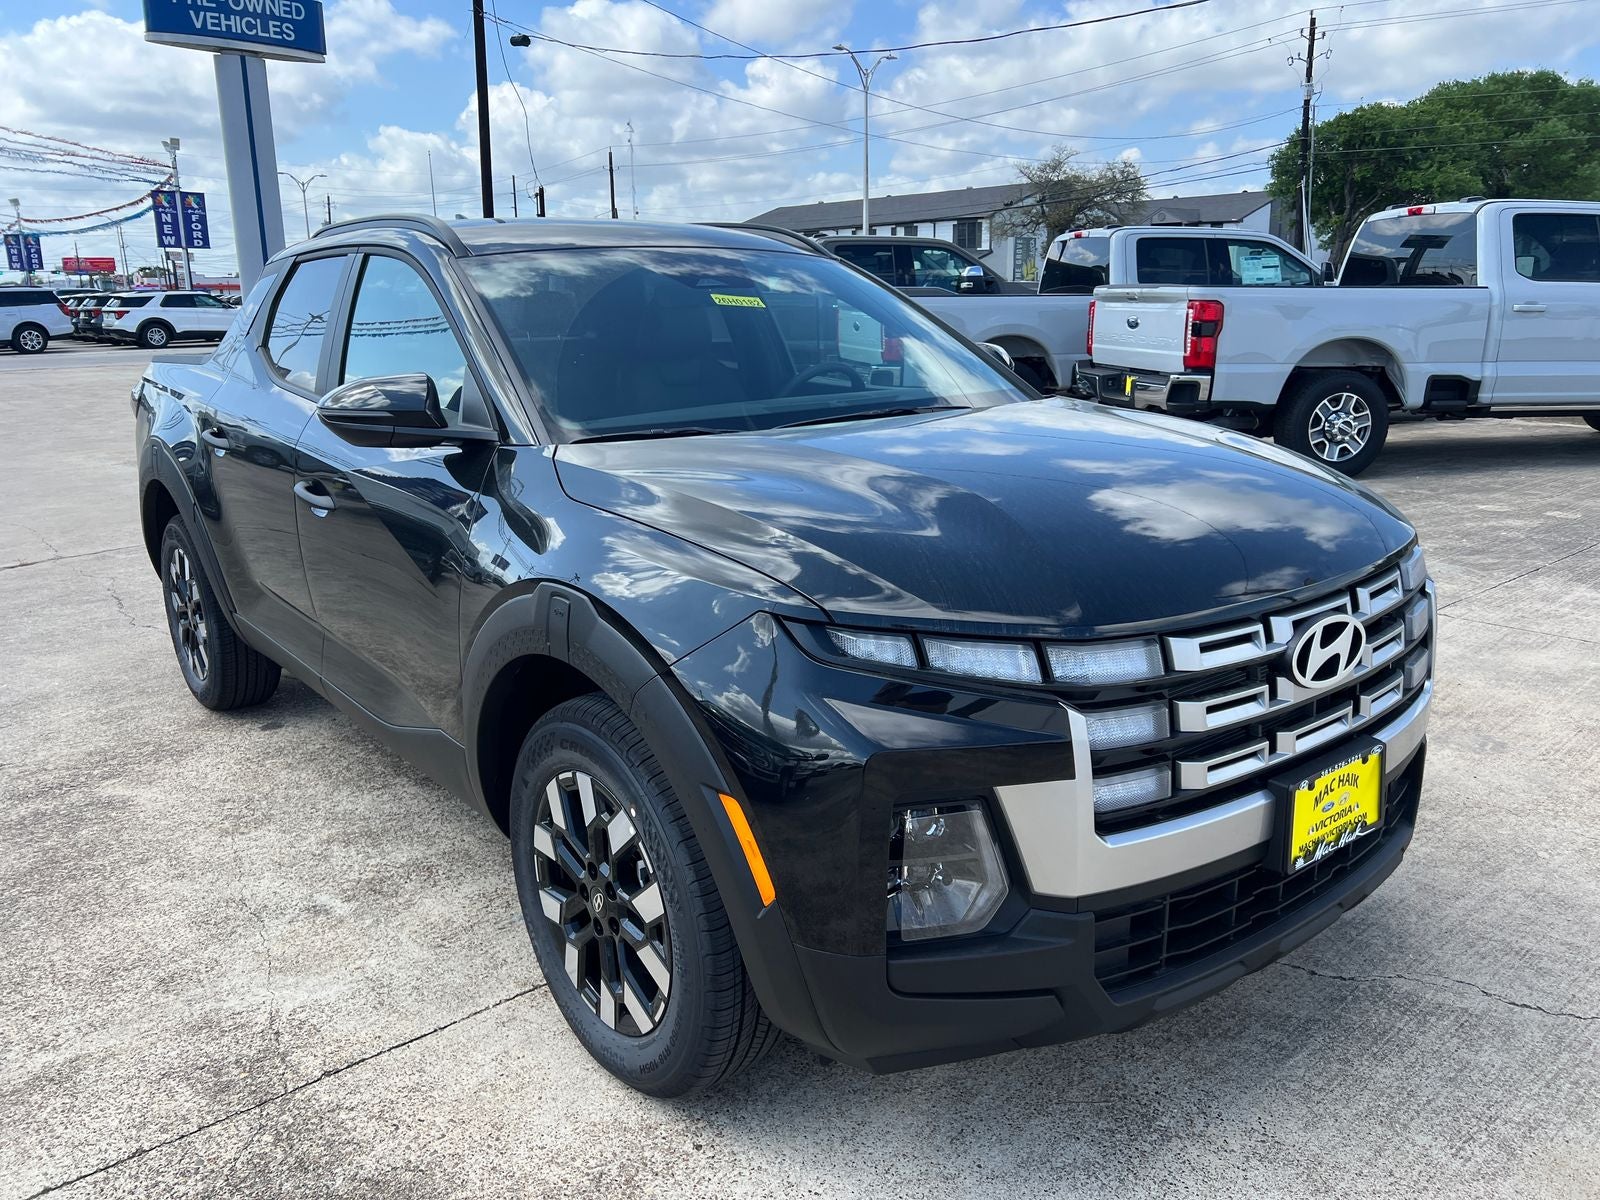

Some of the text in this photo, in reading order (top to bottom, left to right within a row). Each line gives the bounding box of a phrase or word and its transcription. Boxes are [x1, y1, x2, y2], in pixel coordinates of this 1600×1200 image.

[172, 0, 305, 20] OWNED
[189, 10, 295, 41] VEHICLES
[161, 213, 176, 245] NEW
[191, 215, 203, 246] FORD
[10, 248, 20, 268] NEW
[30, 248, 39, 268] FORD
[1313, 778, 1336, 811] MAC
[1338, 773, 1359, 789] HAIK
[1315, 804, 1353, 832] VICTORIA
